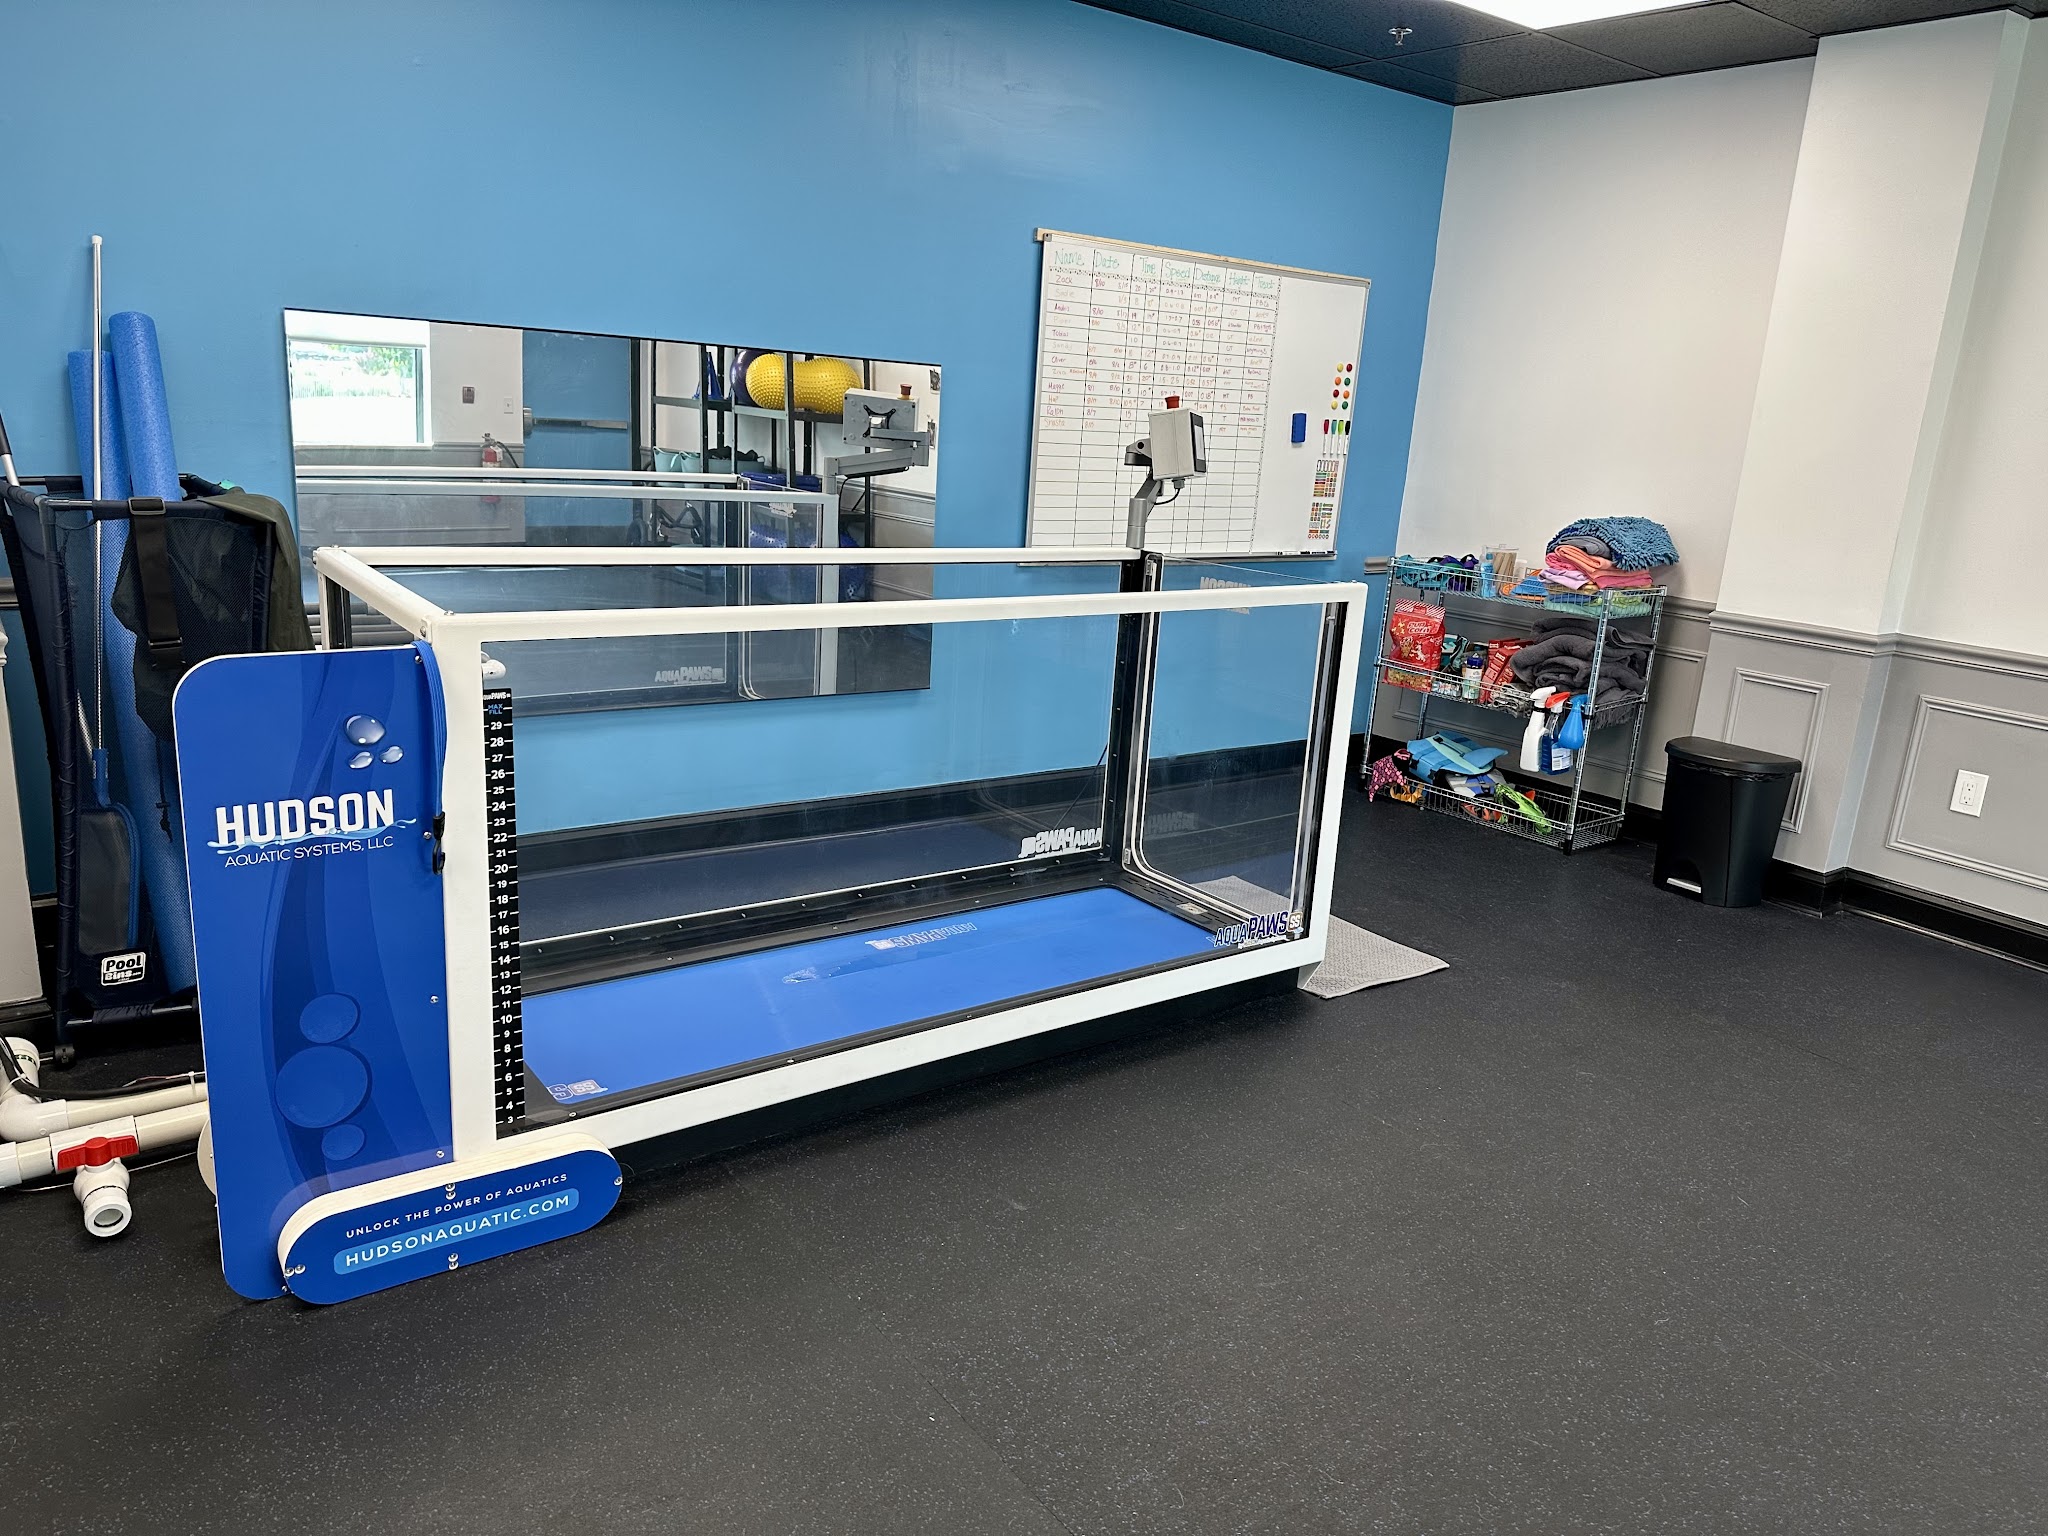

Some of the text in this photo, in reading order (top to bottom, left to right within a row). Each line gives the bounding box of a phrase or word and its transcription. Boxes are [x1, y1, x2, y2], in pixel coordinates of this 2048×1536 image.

[1055, 249, 1084, 265] Name
[1095, 252, 1119, 269] Date
[1140, 257, 1156, 274] Time
[1166, 262, 1191, 279] Speed
[491, 722, 502, 730] 29
[490, 738, 504, 747] 28
[492, 754, 503, 762] 27
[491, 770, 505, 779] 26
[493, 786, 504, 794] 25
[492, 802, 506, 811] 24
[216, 789, 394, 845] HUDSON
[494, 818, 506, 826] 23
[493, 833, 507, 843] 22
[225, 836, 394, 867] AQUATIC SYSTEMS, LLC
[496, 849, 506, 857] 21
[494, 864, 508, 874] 20
[496, 895, 508, 904] 18
[497, 925, 509, 934] 16
[1214, 912, 1289, 946] AQUAPAWS
[106, 955, 141, 971] Pool
[498, 956, 511, 964] 14
[500, 986, 511, 994] 12
[500, 1015, 512, 1023] 10
[504, 1044, 511, 1052] 8
[505, 1073, 512, 1081] 6
[506, 1101, 513, 1110] 4
[346, 1173, 567, 1239] UNLOCK THE POWER OF AQUATICS
[346, 1195, 569, 1266] HUDSONAQUATIC.COM
